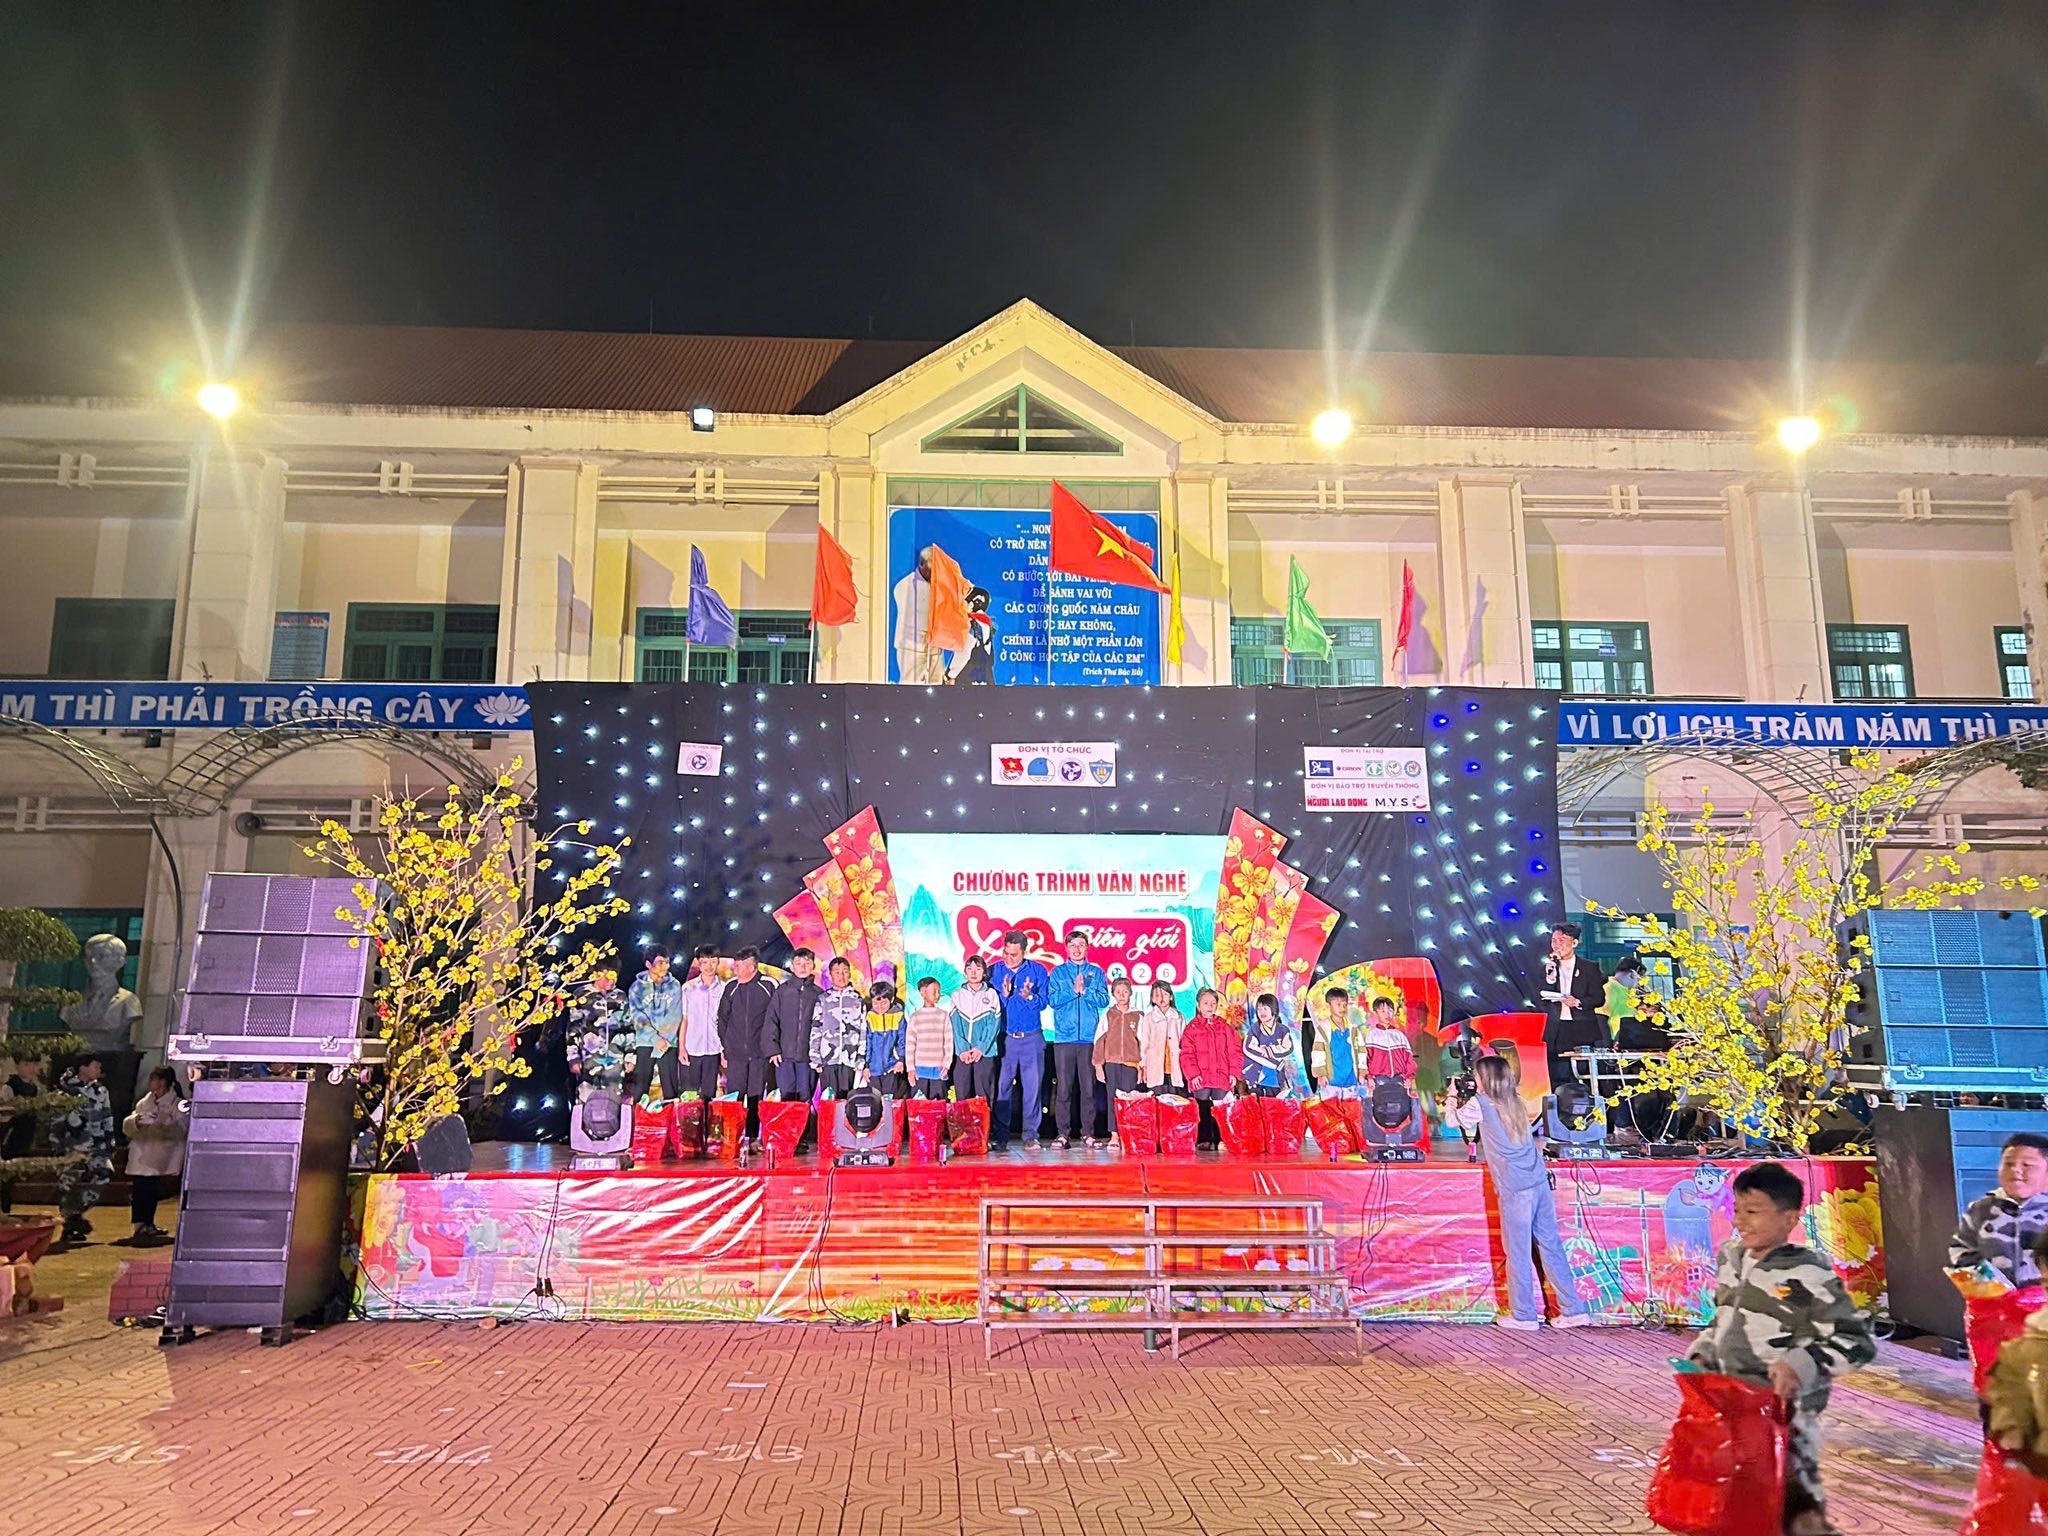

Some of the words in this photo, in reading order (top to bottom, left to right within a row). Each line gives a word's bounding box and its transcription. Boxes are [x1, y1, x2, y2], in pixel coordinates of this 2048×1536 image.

[990, 537, 1002, 549] CÓ
[1006, 536, 1025, 549] TRỞ
[1027, 538, 1047, 550] NÊN
[1029, 554, 1048, 565] DÂN
[1002, 569, 1015, 581] CÓ
[1018, 569, 1043, 581] BƯỚC
[1033, 583, 1046, 598] ĐỂ
[1078, 589, 1094, 598] VAI
[1095, 586, 1112, 598] VỚI
[1005, 602, 1024, 614] CÁC
[1027, 602, 1059, 614] CƯỜNG
[1062, 601, 1088, 616] QUỐC
[1091, 603, 1112, 615] NĂM
[1114, 603, 1140, 615] CHÂU
[1029, 619, 1055, 631] ĐƯỢC
[1058, 620, 1077, 631] HAY
[1080, 619, 1116, 632] KHÔNG,
[1002, 634, 1032, 646] CHÍNH
[1035, 634, 1047, 646] LÀ
[1050, 634, 1070, 646] NHỜ
[1073, 635, 1093, 648] MỘT
[1097, 632, 1122, 647] PHẦN
[1125, 636, 1143, 647] LỚN
[1000, 649, 1007, 661] Ở
[1010, 650, 1036, 662] CÔNG
[1062, 651, 1079, 664] TẬP
[1082, 650, 1102, 663] CỦA
[1104, 650, 1123, 663] CÁC
[49, 688, 116, 720] THÌ
[130, 686, 224, 721] PHẢI
[239, 685, 372, 721] TRỒNG
[385, 691, 463, 723] CÂY
[1566, 708, 1600, 739] VÌ
[1613, 711, 1667, 743] LỢI
[1745, 711, 1844, 741] TRĂM
[1856, 712, 1932, 742] NĂM
[1941, 712, 1997, 741] THÌ
[1041, 746, 1049, 755] VỊ
[953, 869, 1030, 892] CHƯƠNG
[1036, 869, 1090, 892] TRÌNH
[1097, 870, 1132, 892] VĂN
[1126, 924, 1181, 960] giới
